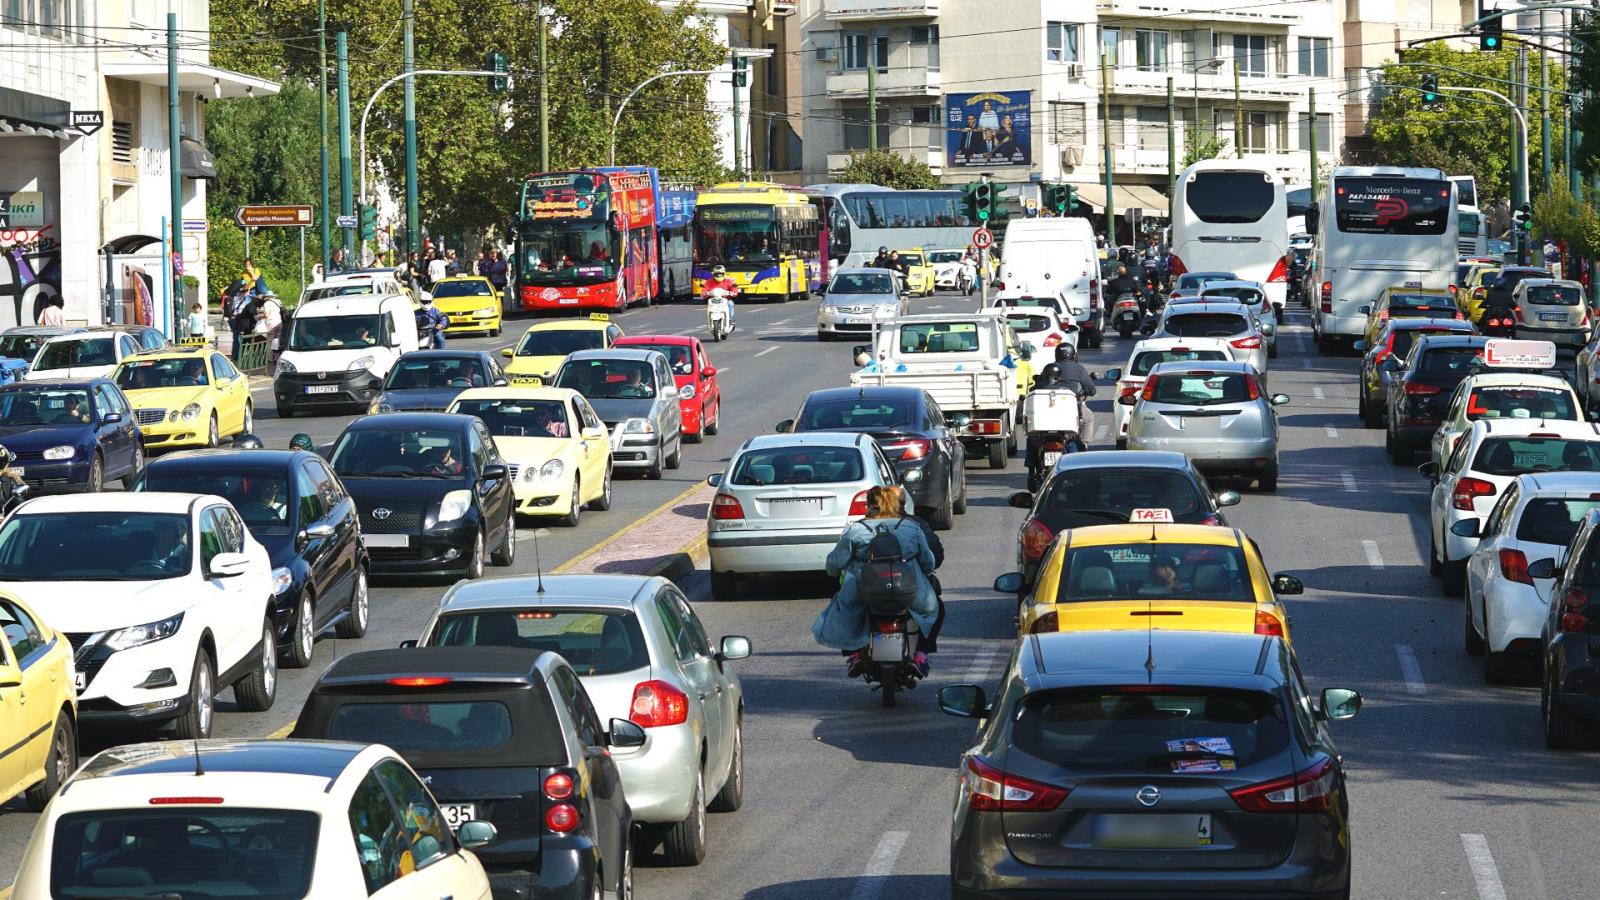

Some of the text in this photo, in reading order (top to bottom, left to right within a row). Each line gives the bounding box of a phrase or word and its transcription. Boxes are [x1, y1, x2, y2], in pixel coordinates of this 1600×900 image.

[1366, 186, 1422, 195] Mercedes-Benz
[1348, 193, 1391, 201] PAPADAKIS
[1468, 394, 1488, 414] L
[1135, 510, 1168, 519] ΤΑΞΙ
